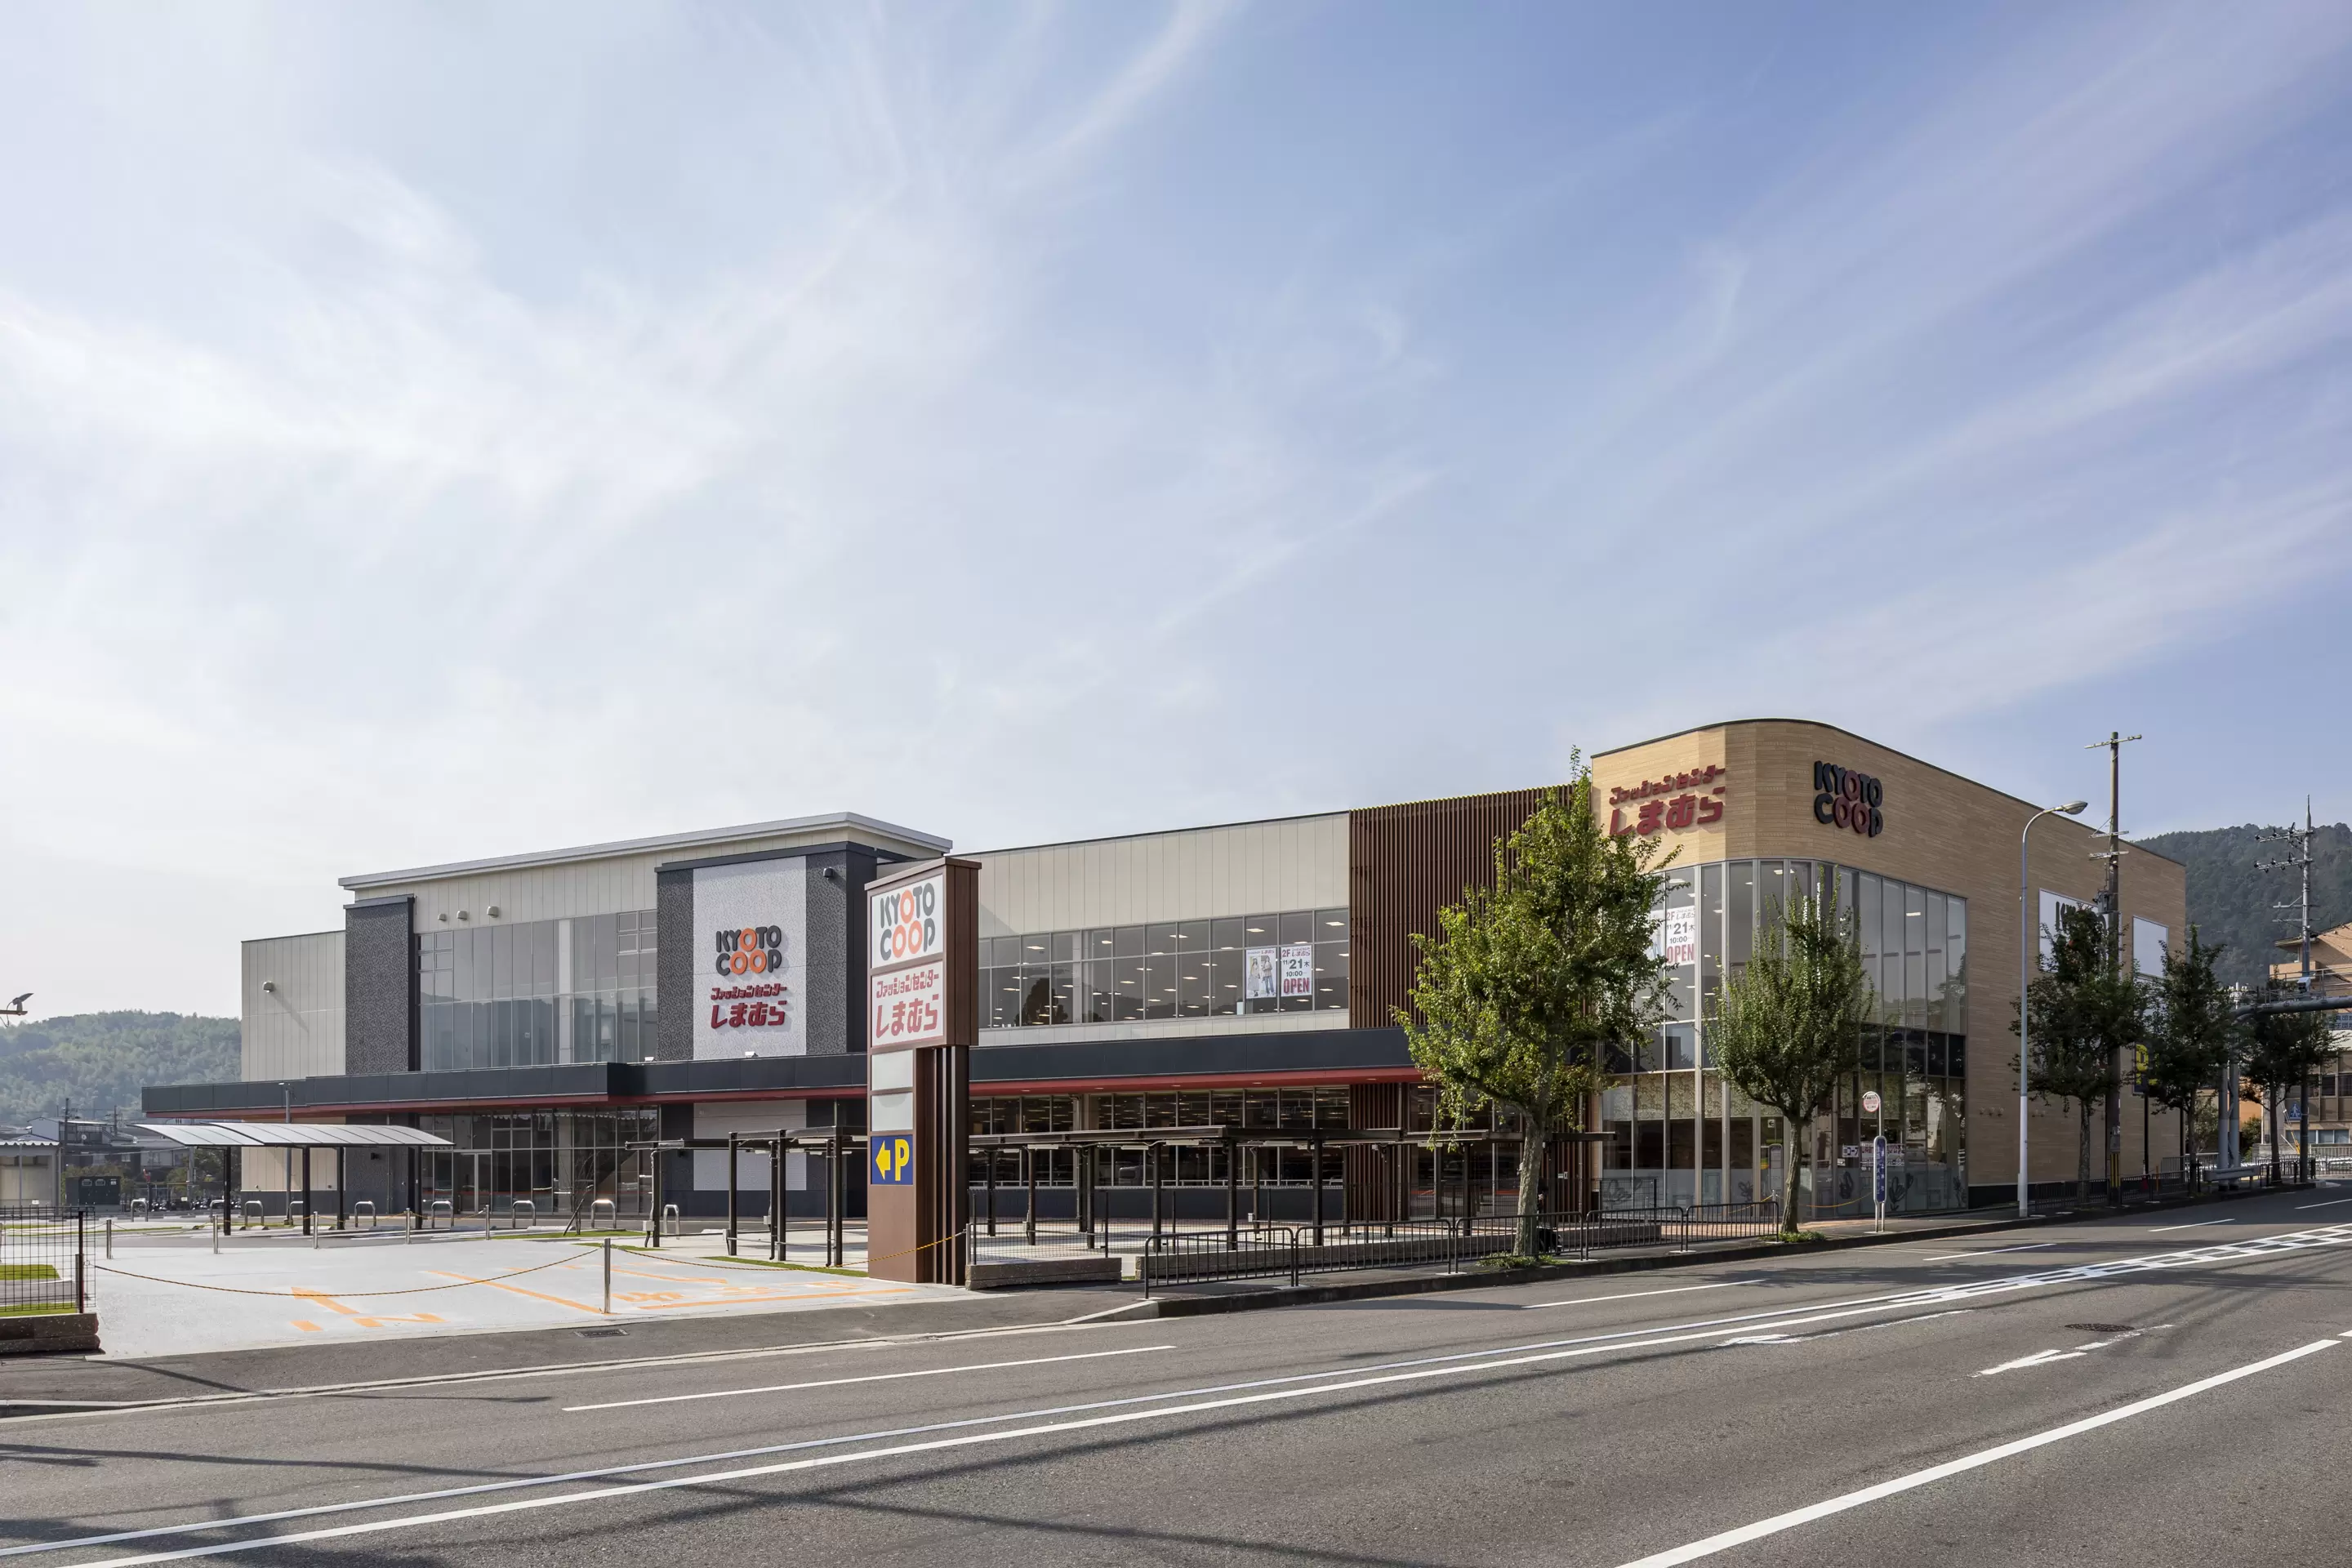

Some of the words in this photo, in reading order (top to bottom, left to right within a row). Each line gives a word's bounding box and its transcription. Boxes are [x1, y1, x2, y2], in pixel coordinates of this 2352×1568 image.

[1609, 764, 1726, 804] ファッションセンター
[1814, 760, 1882, 808] KYOTO
[1609, 786, 1726, 835] しまむら
[1814, 793, 1883, 837] COOP
[880, 883, 935, 929] KYOTO
[716, 925, 782, 952] KYOTO
[880, 918, 936, 961] COOP
[1667, 943, 1695, 964] OPEN
[716, 949, 782, 976] COOP
[711, 983, 787, 1000] ファッションセンター
[876, 969, 939, 998] ファッションセンター
[1284, 978, 1310, 994] OPEN
[711, 1000, 787, 1029] しまむら
[876, 994, 939, 1038] しまむら
[894, 1138, 910, 1182] P
